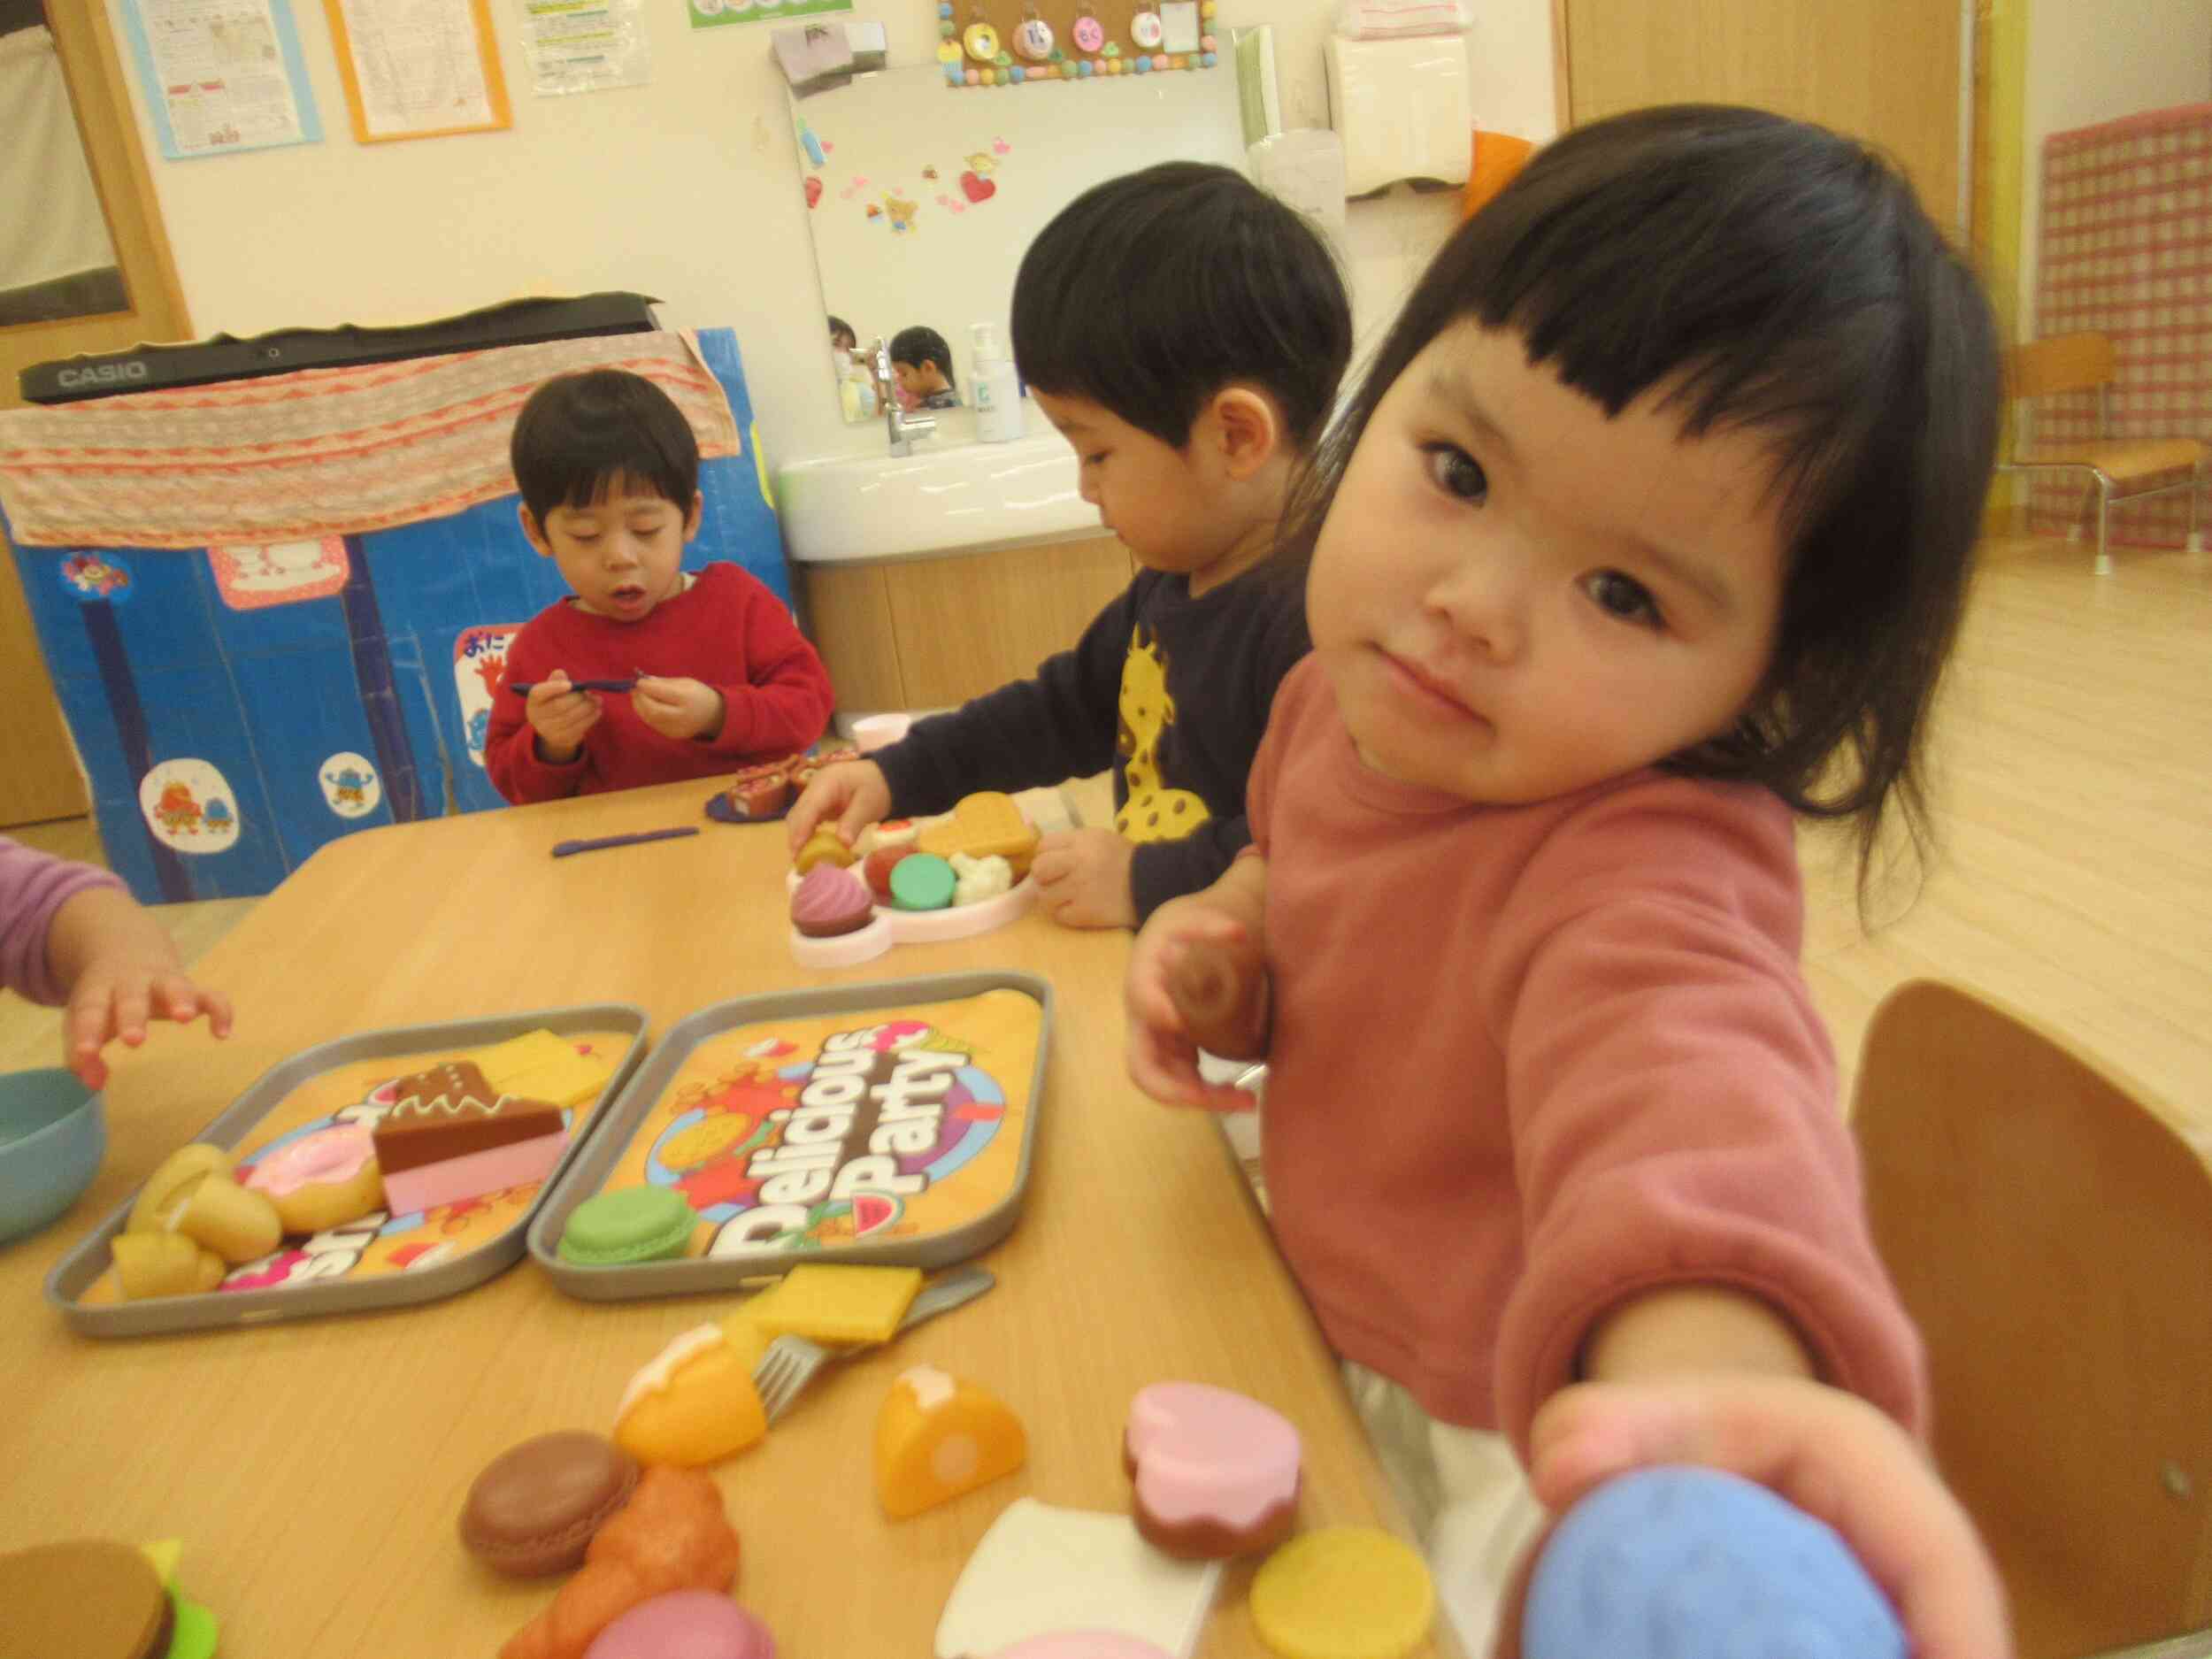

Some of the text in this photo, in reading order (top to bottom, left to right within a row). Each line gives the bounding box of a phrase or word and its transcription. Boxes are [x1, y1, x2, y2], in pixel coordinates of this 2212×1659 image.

[58, 361, 148, 388] CASIO
[707, 1025, 890, 1262] Delicious
[826, 1028, 972, 1202] Party
